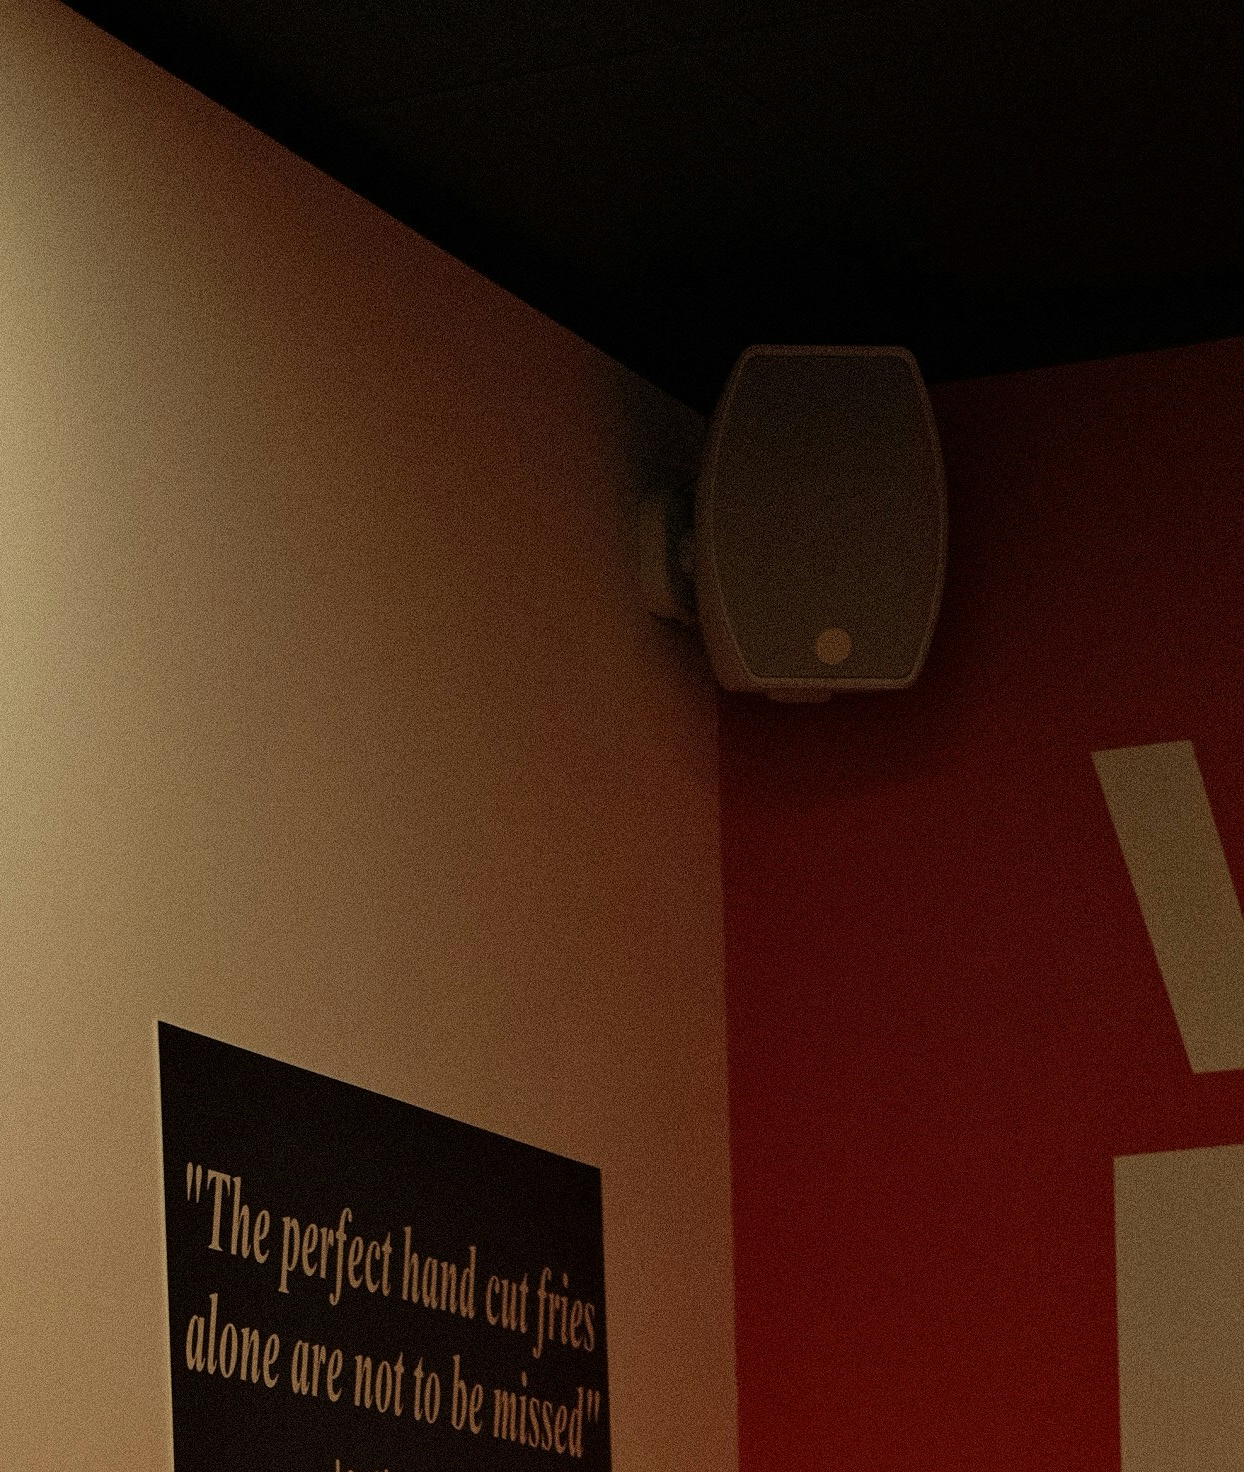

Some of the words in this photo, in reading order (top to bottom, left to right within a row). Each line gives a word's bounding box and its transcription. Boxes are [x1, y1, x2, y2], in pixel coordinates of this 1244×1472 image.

[187, 1164, 270, 1262] "The
[279, 1209, 391, 1304] perfect
[403, 1228, 475, 1316] hand
[487, 1278, 527, 1331] cut
[534, 1270, 593, 1356] fries
[186, 1295, 279, 1386] alone
[291, 1342, 342, 1400] are
[355, 1355, 404, 1414] not
[415, 1361, 440, 1422] to
[452, 1357, 482, 1432] be
[494, 1374, 599, 1455] missed"
